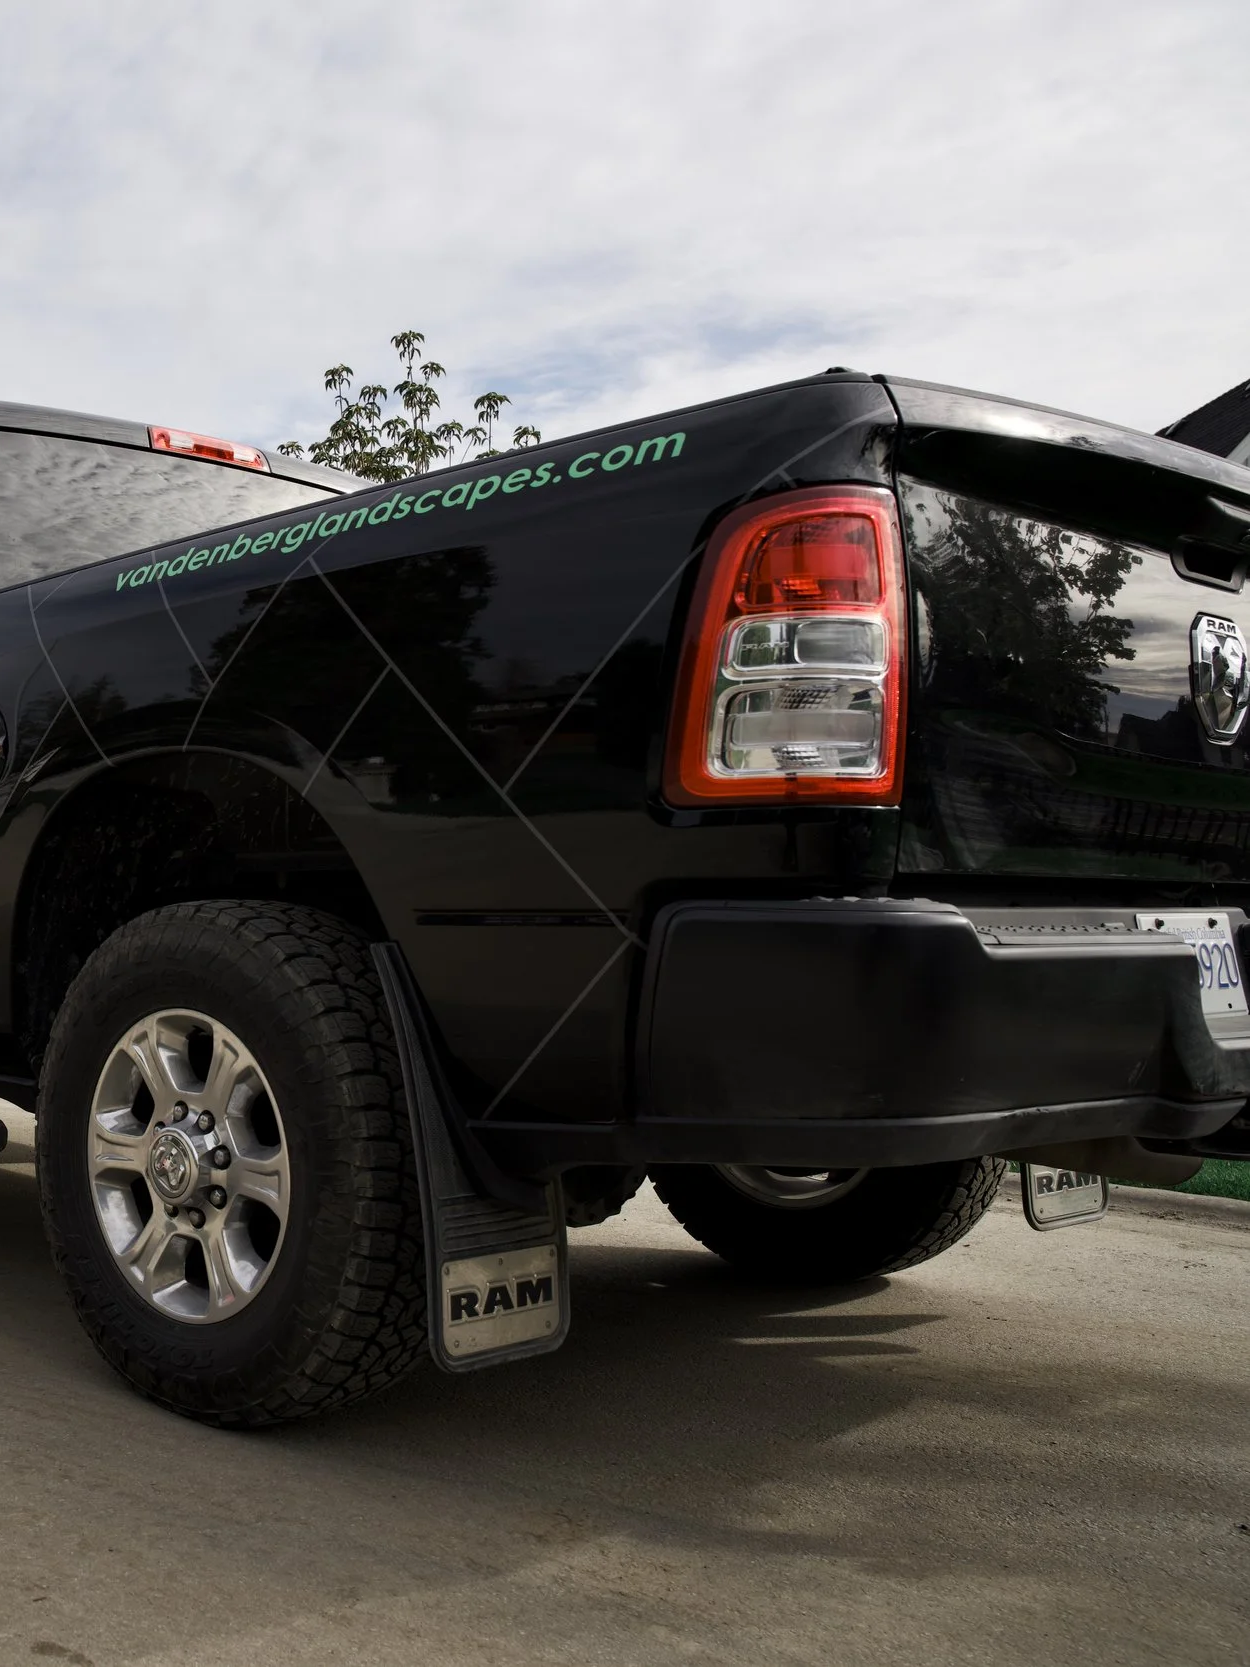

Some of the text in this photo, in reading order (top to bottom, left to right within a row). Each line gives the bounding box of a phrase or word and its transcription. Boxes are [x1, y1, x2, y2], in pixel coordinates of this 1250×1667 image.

[116, 431, 687, 592] vandenberglandscapes.com
[1206, 619, 1237, 635] RAM
[450, 1275, 553, 1322] RAM
